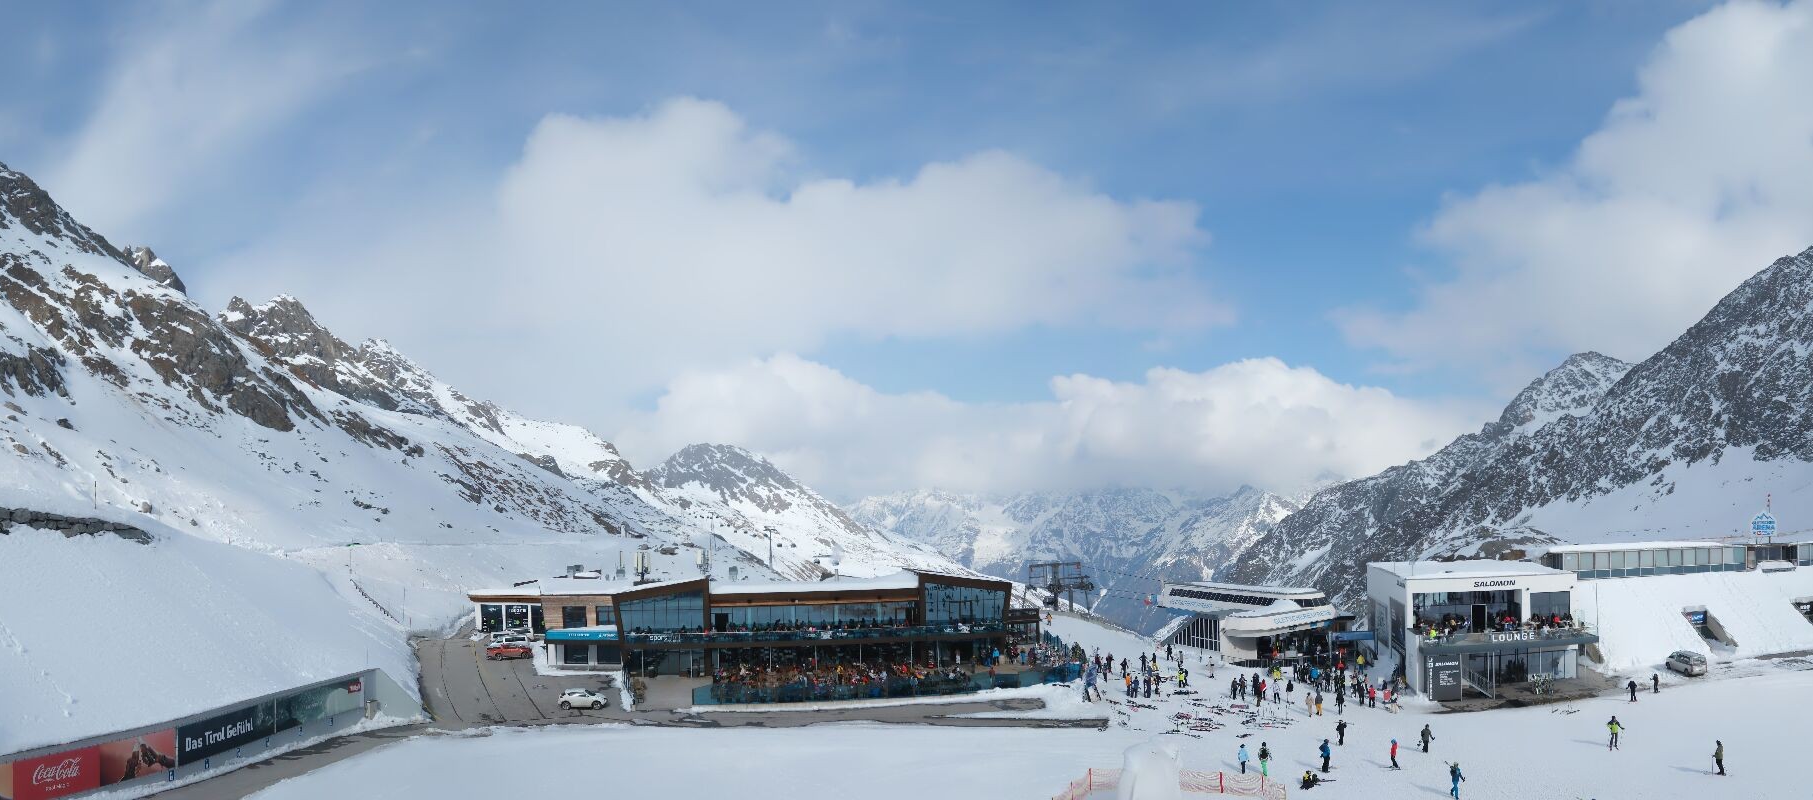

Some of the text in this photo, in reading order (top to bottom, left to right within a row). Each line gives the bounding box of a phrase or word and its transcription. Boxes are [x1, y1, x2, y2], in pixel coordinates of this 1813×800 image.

[1473, 580, 1516, 588] SALOMON
[1492, 632, 1535, 642] LOUNGE
[185, 717, 254, 752] Das Tirol Gefühl
